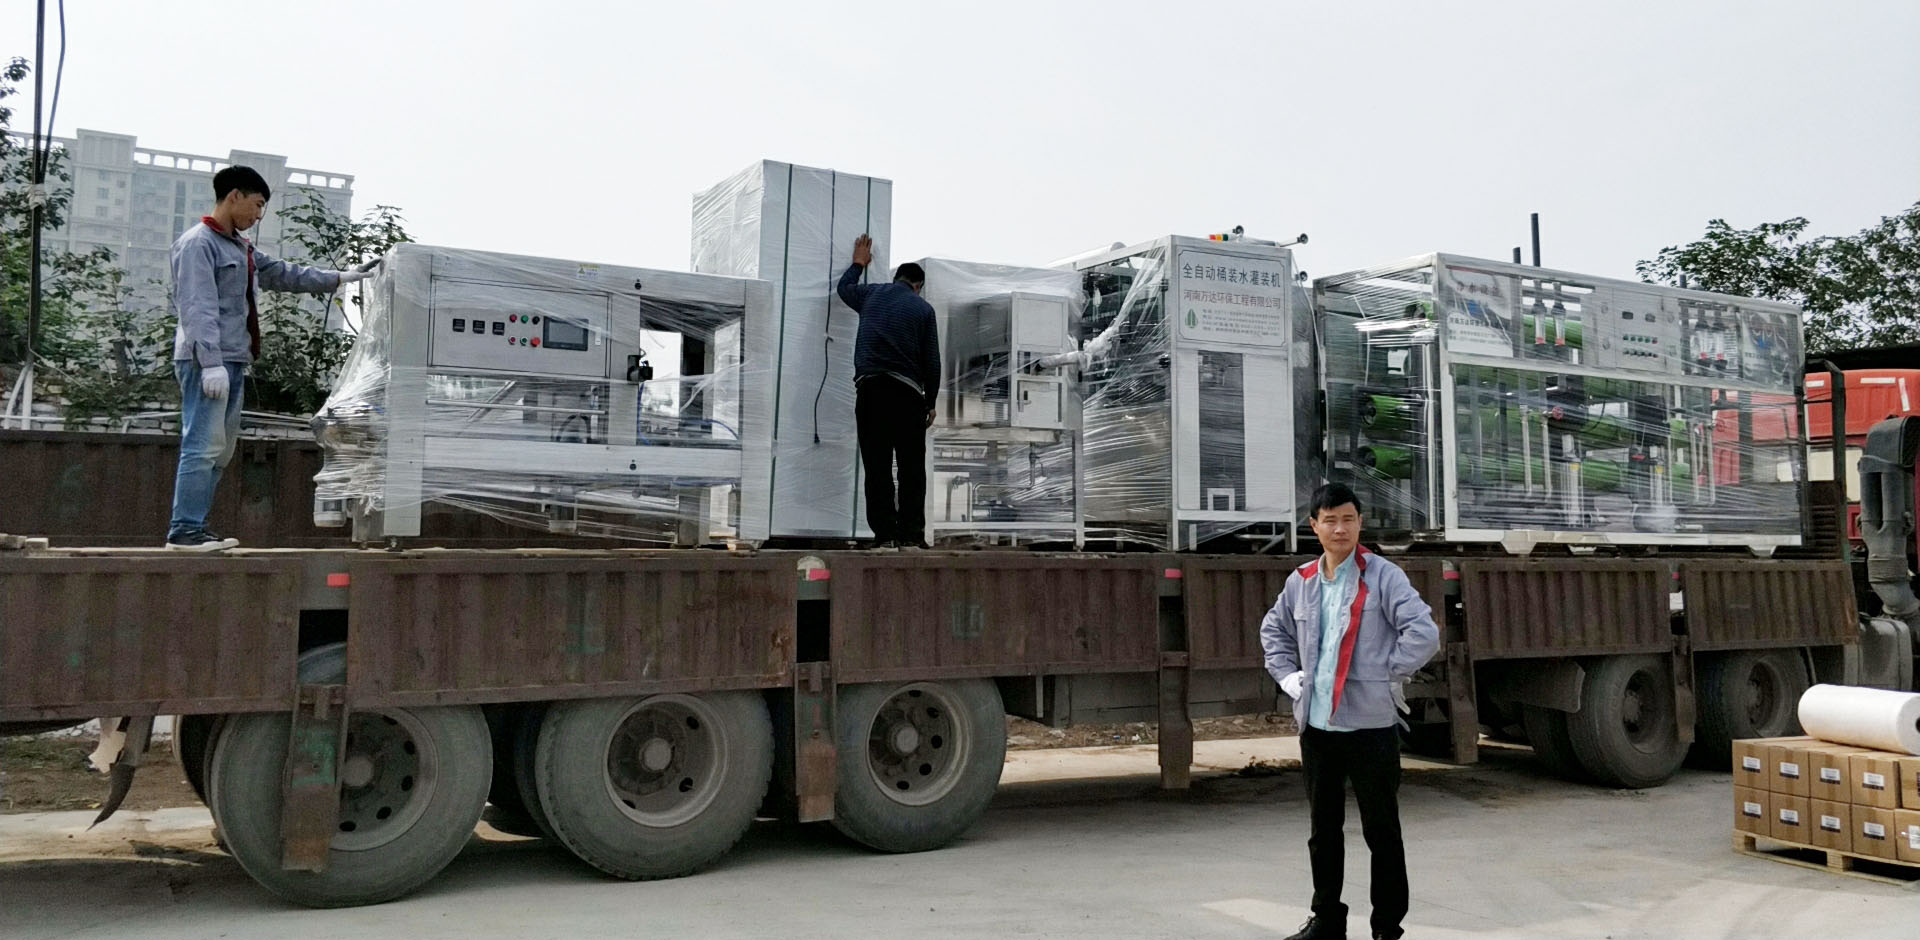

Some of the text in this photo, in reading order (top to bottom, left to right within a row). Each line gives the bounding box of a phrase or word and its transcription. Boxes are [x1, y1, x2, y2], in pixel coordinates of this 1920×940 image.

[1183, 262, 1280, 288] 全自动桶装水灌装机
[1184, 289, 1280, 309] 河南万达环保工程有限公司
